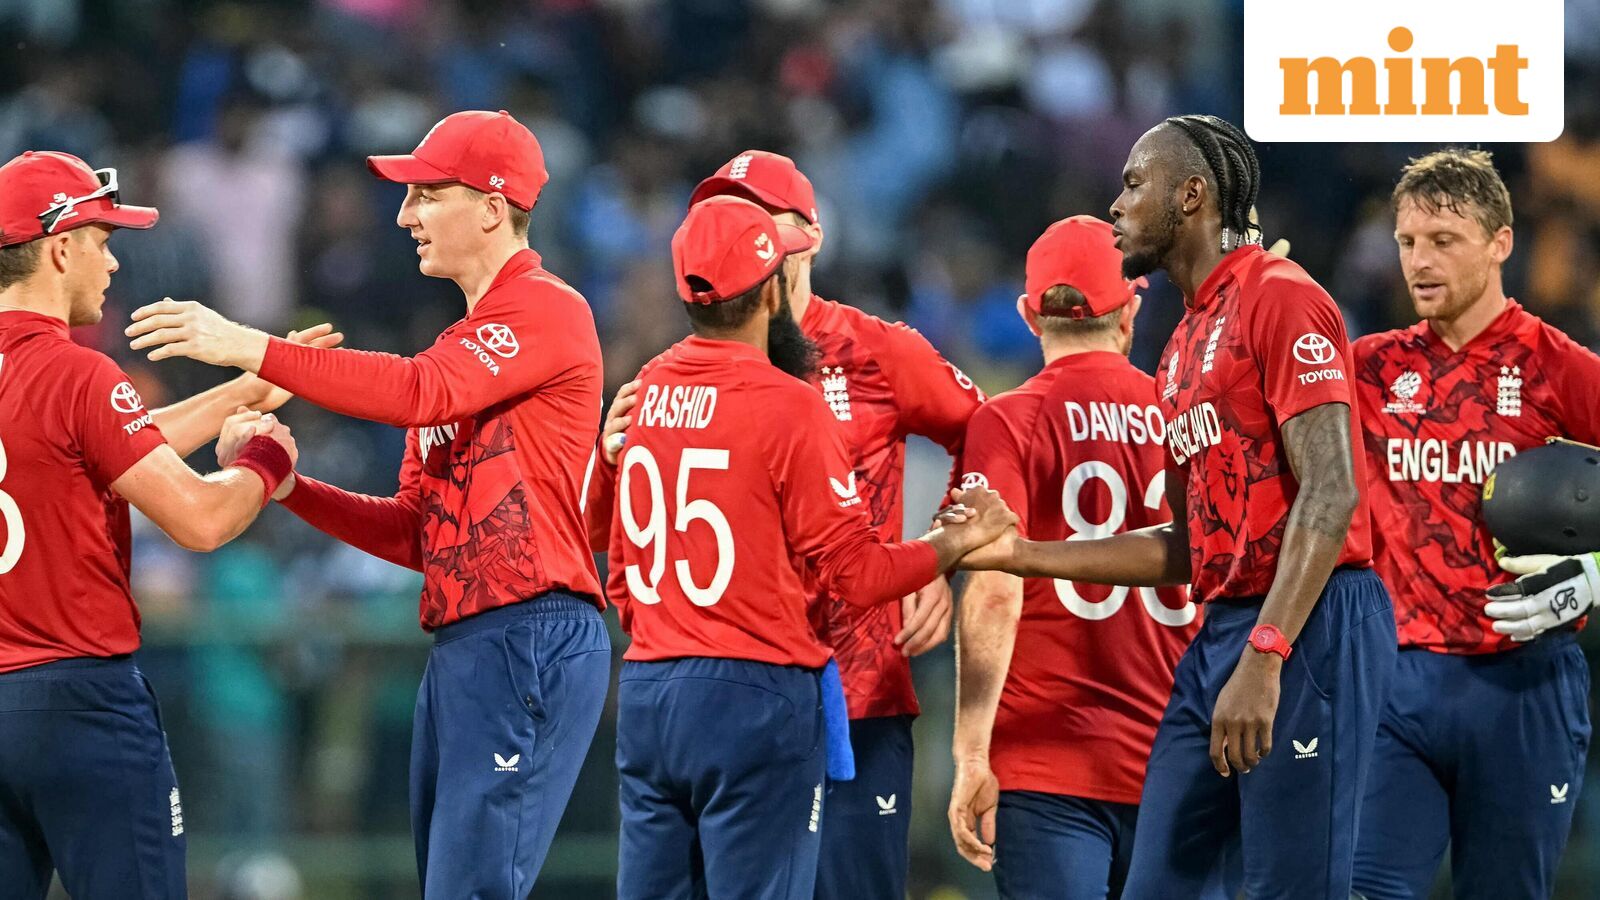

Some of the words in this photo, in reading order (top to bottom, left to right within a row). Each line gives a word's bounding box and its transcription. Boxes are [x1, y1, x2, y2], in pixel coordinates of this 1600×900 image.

[489, 175, 505, 190] 92
[459, 337, 500, 377] TOYOTA
[1297, 369, 1345, 386] TOYOTA
[637, 384, 717, 429] RASHID
[1166, 401, 1222, 466] ENGLAND
[619, 445, 735, 607] 95
